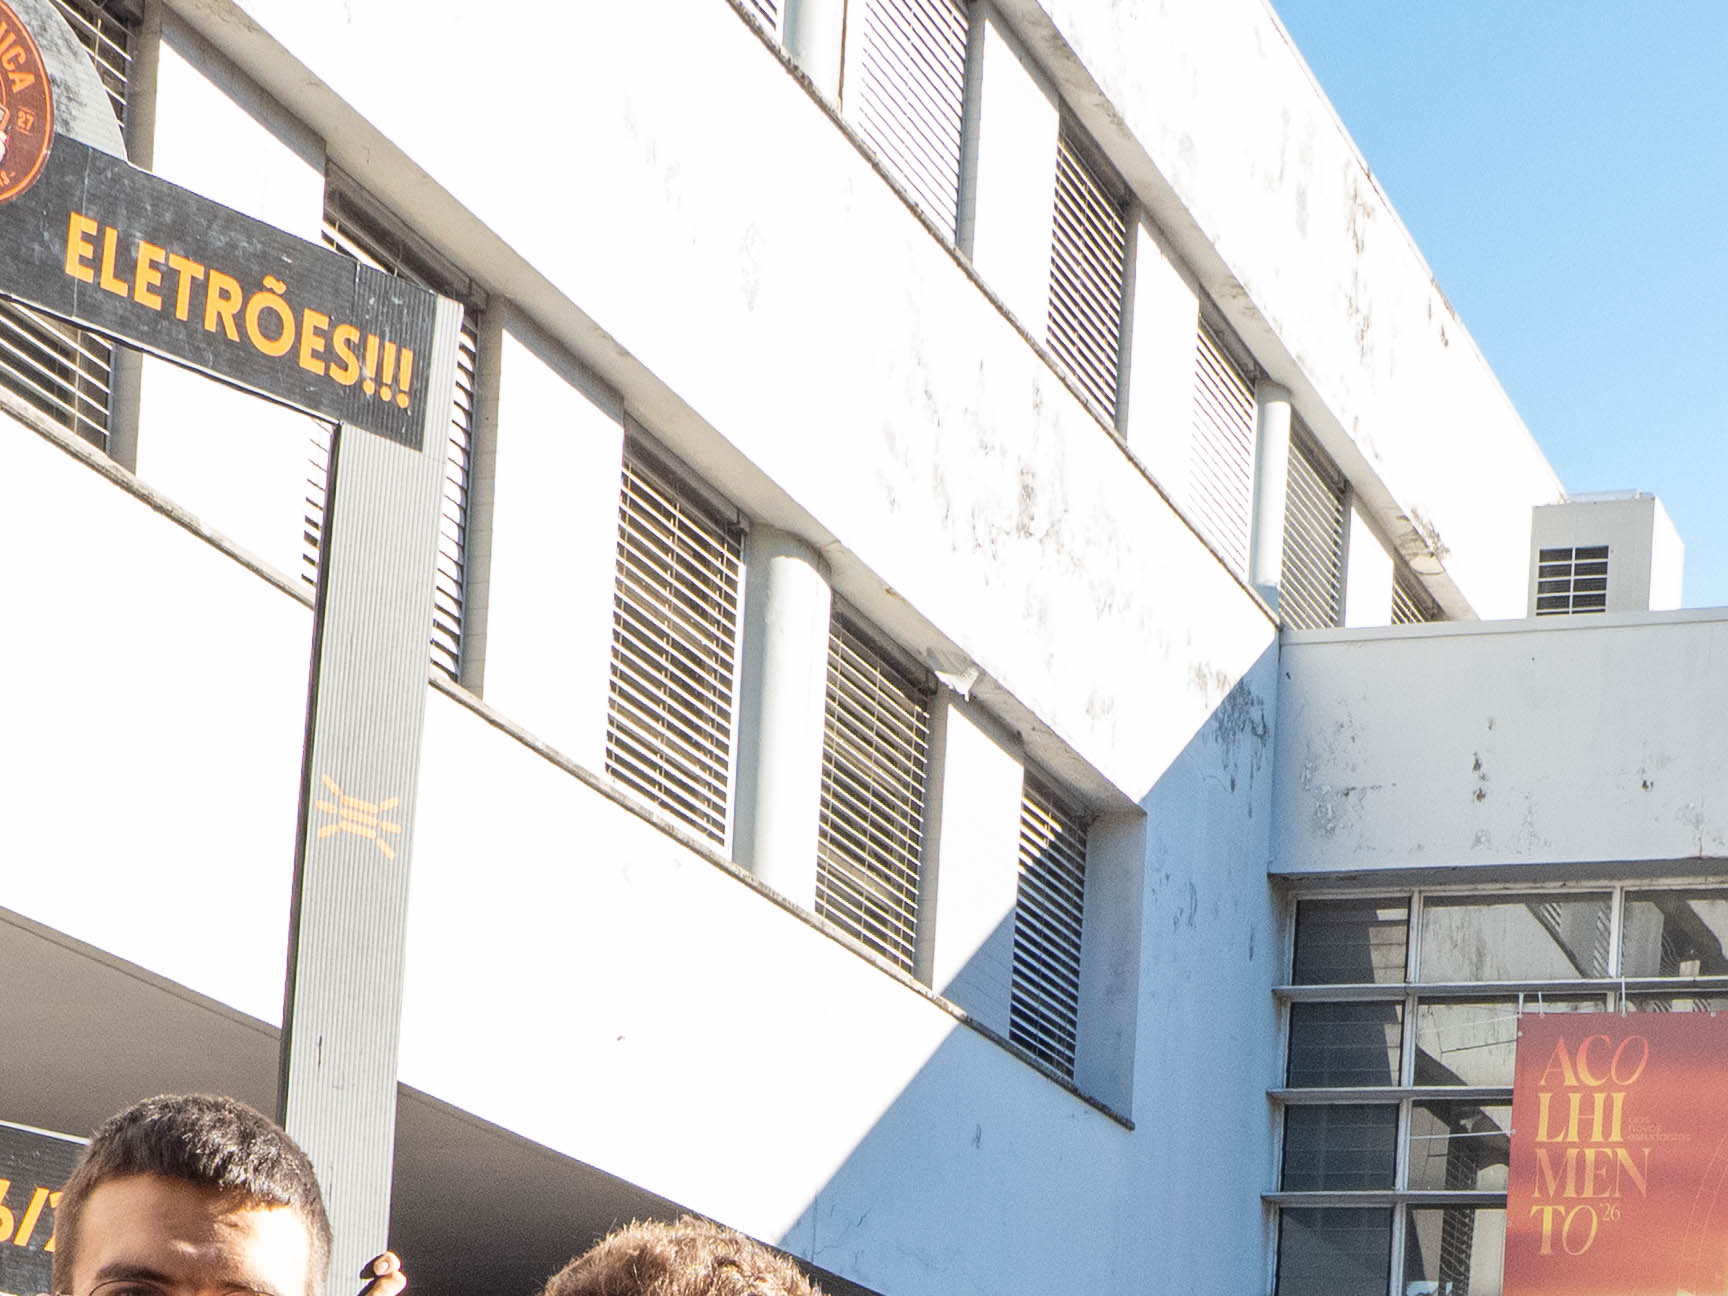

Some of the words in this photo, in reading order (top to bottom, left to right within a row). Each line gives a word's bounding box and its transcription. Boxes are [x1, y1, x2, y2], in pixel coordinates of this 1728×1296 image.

[17, 111, 35, 131] 27
[65, 209, 413, 411] ELETRÕES!!!
[1538, 1034, 1650, 1087] ACO
[1535, 1092, 1627, 1142] LHI
[1531, 1148, 1652, 1199] MEN
[1529, 1204, 1598, 1256] TO
